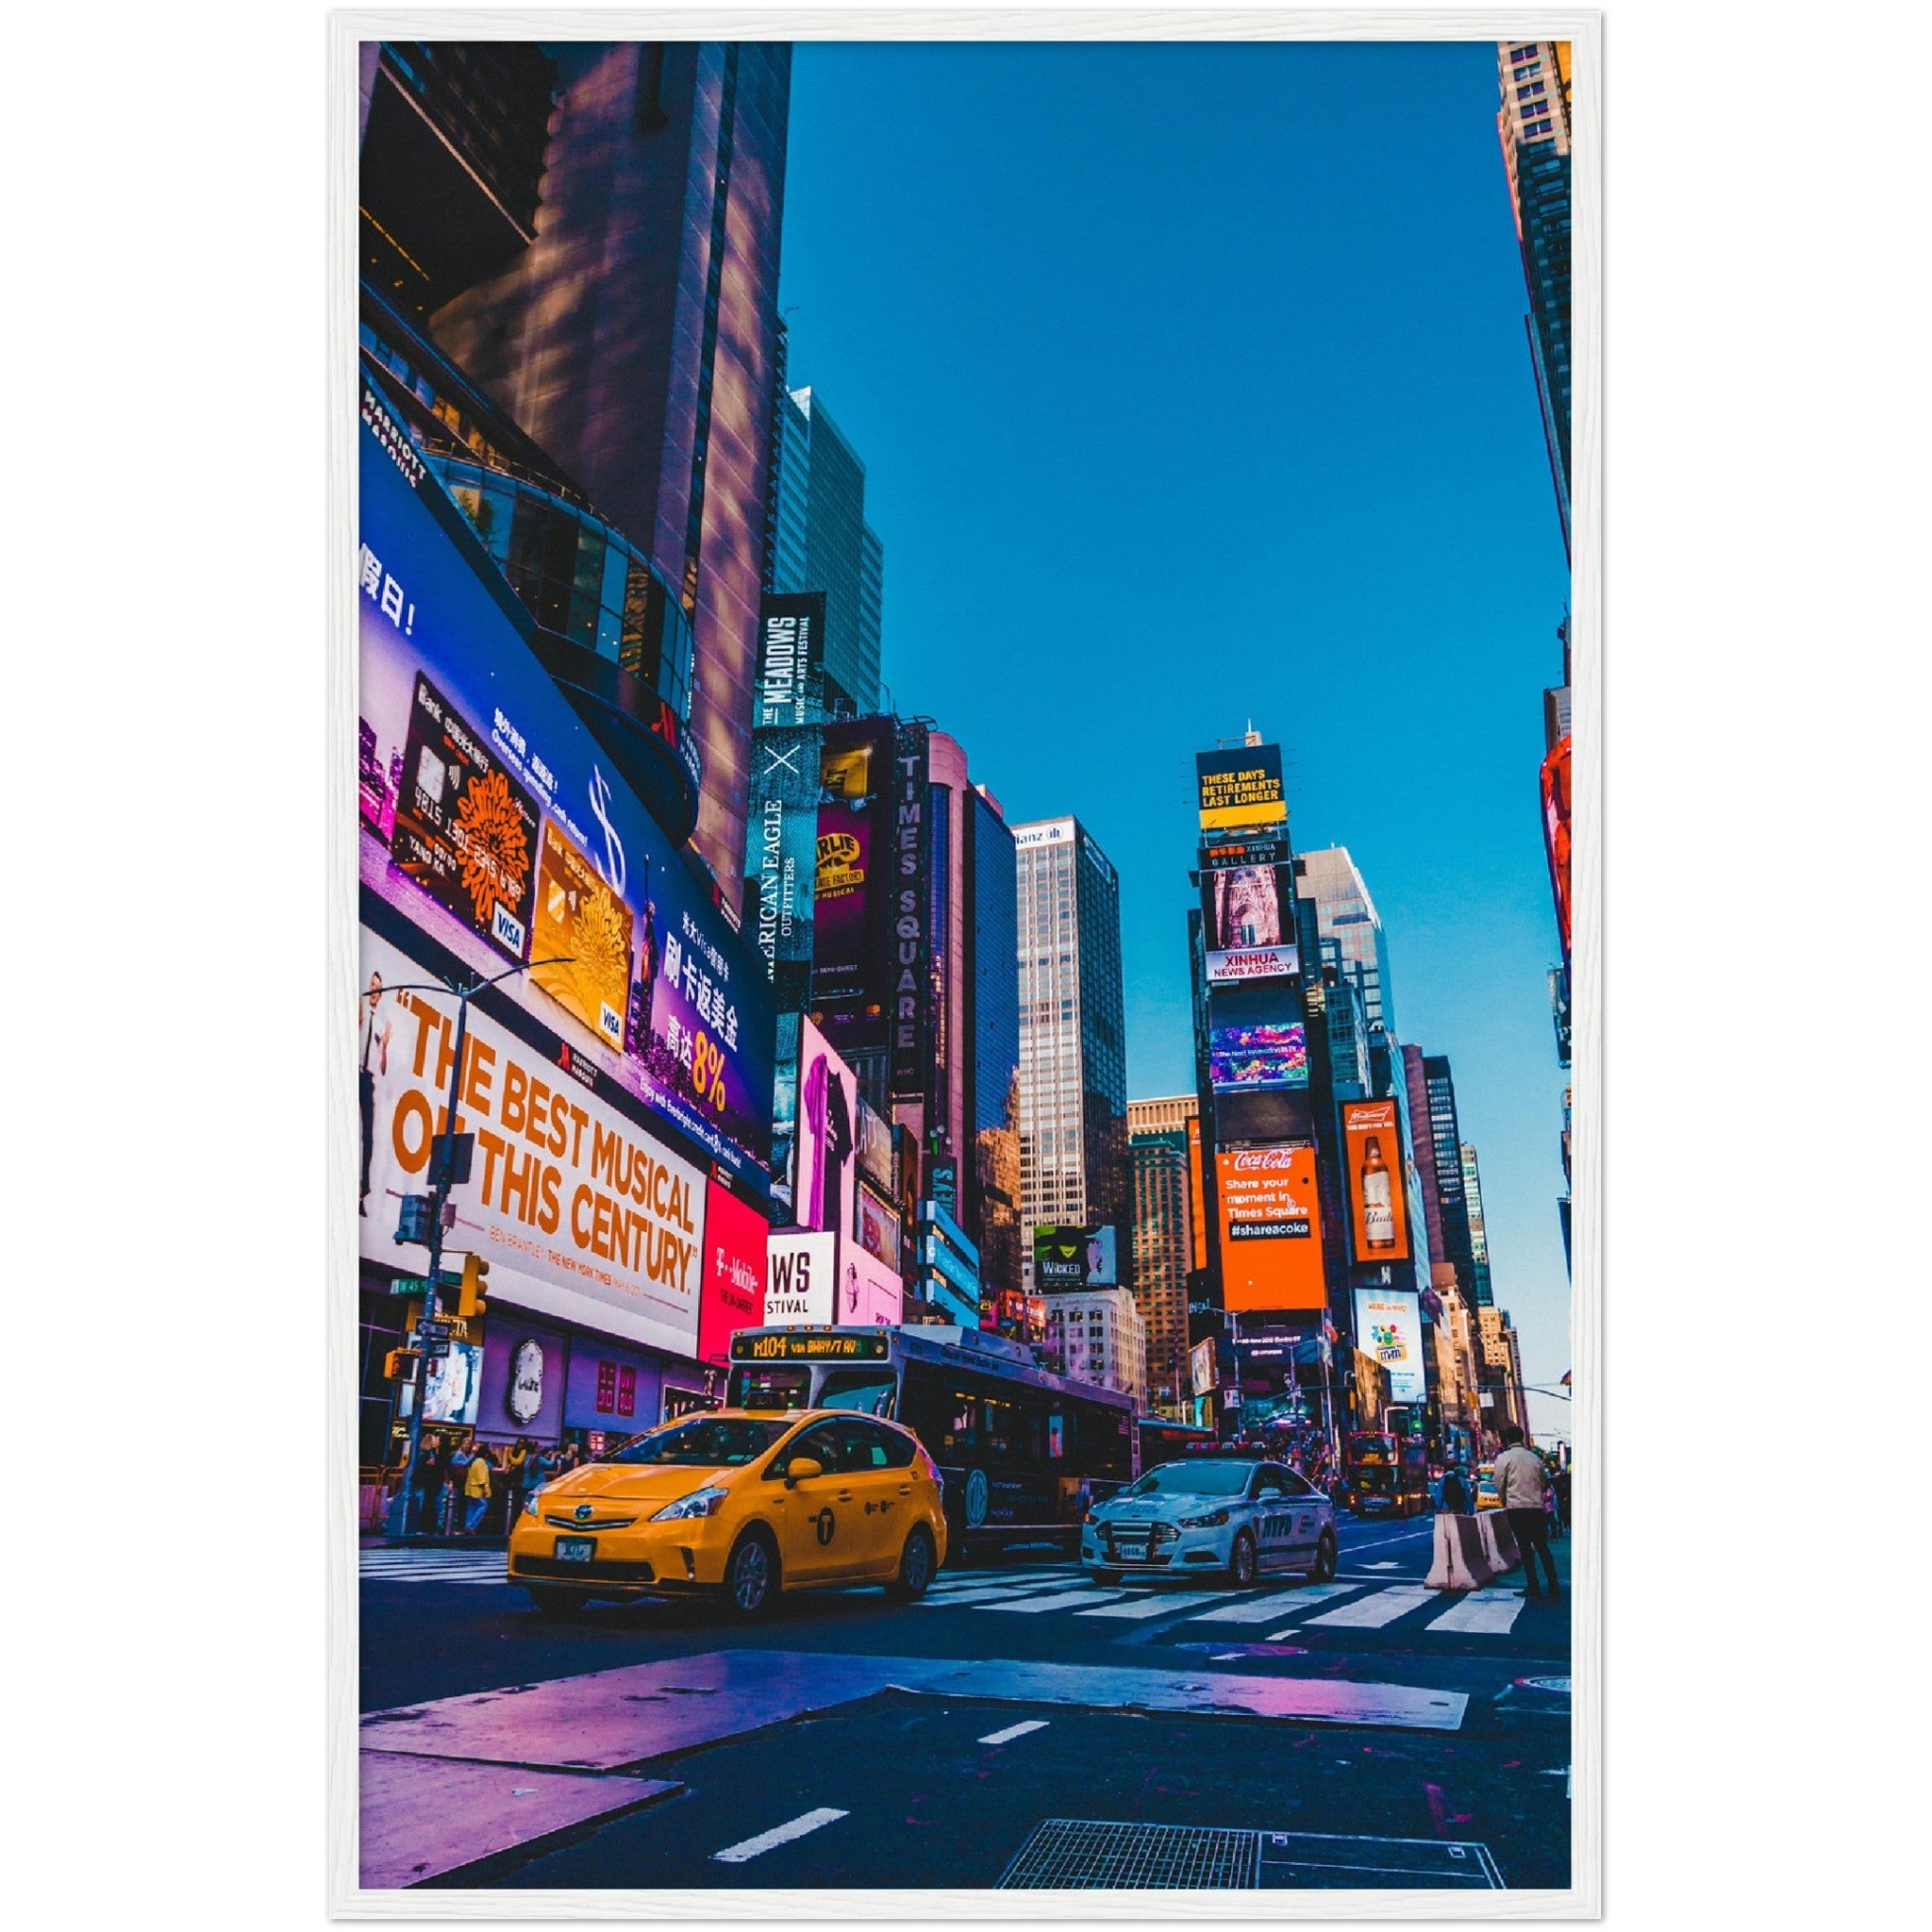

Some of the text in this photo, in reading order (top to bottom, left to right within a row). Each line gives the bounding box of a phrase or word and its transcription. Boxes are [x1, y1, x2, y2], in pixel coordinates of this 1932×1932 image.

[797, 617, 809, 655] FESTIVAL
[762, 617, 796, 725] THE MEADOWS
[796, 658, 808, 680] ARTS
[795, 696, 805, 724] MUSIC
[1202, 769, 1265, 786] THESE DAYS
[1202, 778, 1281, 796] RETIREMENTS
[1203, 790, 1278, 808] LAST LONGER
[897, 756, 920, 874] TIMES
[1211, 853, 1275, 866] GALLERY
[832, 871, 862, 885] FACTORY
[758, 800, 782, 983] ERICAN EAGLE
[781, 858, 795, 937] OUTFITTERS
[497, 911, 520, 947] VISA
[897, 891, 921, 1048] SQUARE
[1214, 962, 1292, 977] NEWS AGENCY
[1225, 953, 1279, 967] XINHUA
[604, 1007, 620, 1036] VISA
[692, 1030, 726, 1111] 8%
[501, 1059, 590, 1168] BEST
[591, 1120, 694, 1235] MUSICAL
[1234, 1148, 1293, 1172] Coca-Cola
[477, 1126, 562, 1235] THIS
[1225, 1178, 1290, 1191] Share your
[1226, 1191, 1276, 1205] moment
[1228, 1207, 1308, 1221] Times Square
[1231, 1222, 1309, 1237] #shareacoke
[490, 1225, 506, 1243] BEN
[548, 1249, 562, 1266] THE
[562, 1256, 576, 1272] NEW
[578, 1262, 594, 1277] YORK
[595, 1269, 612, 1287] TIMES
[765, 1253, 810, 1295] WS
[766, 1301, 808, 1314] STIVAL
[754, 1336, 787, 1357] M104
[807, 1340, 842, 1354] BWAY/7
[842, 1340, 857, 1354] AV
[822, 1514, 830, 1541] T
[1262, 1514, 1291, 1538] NYPD
